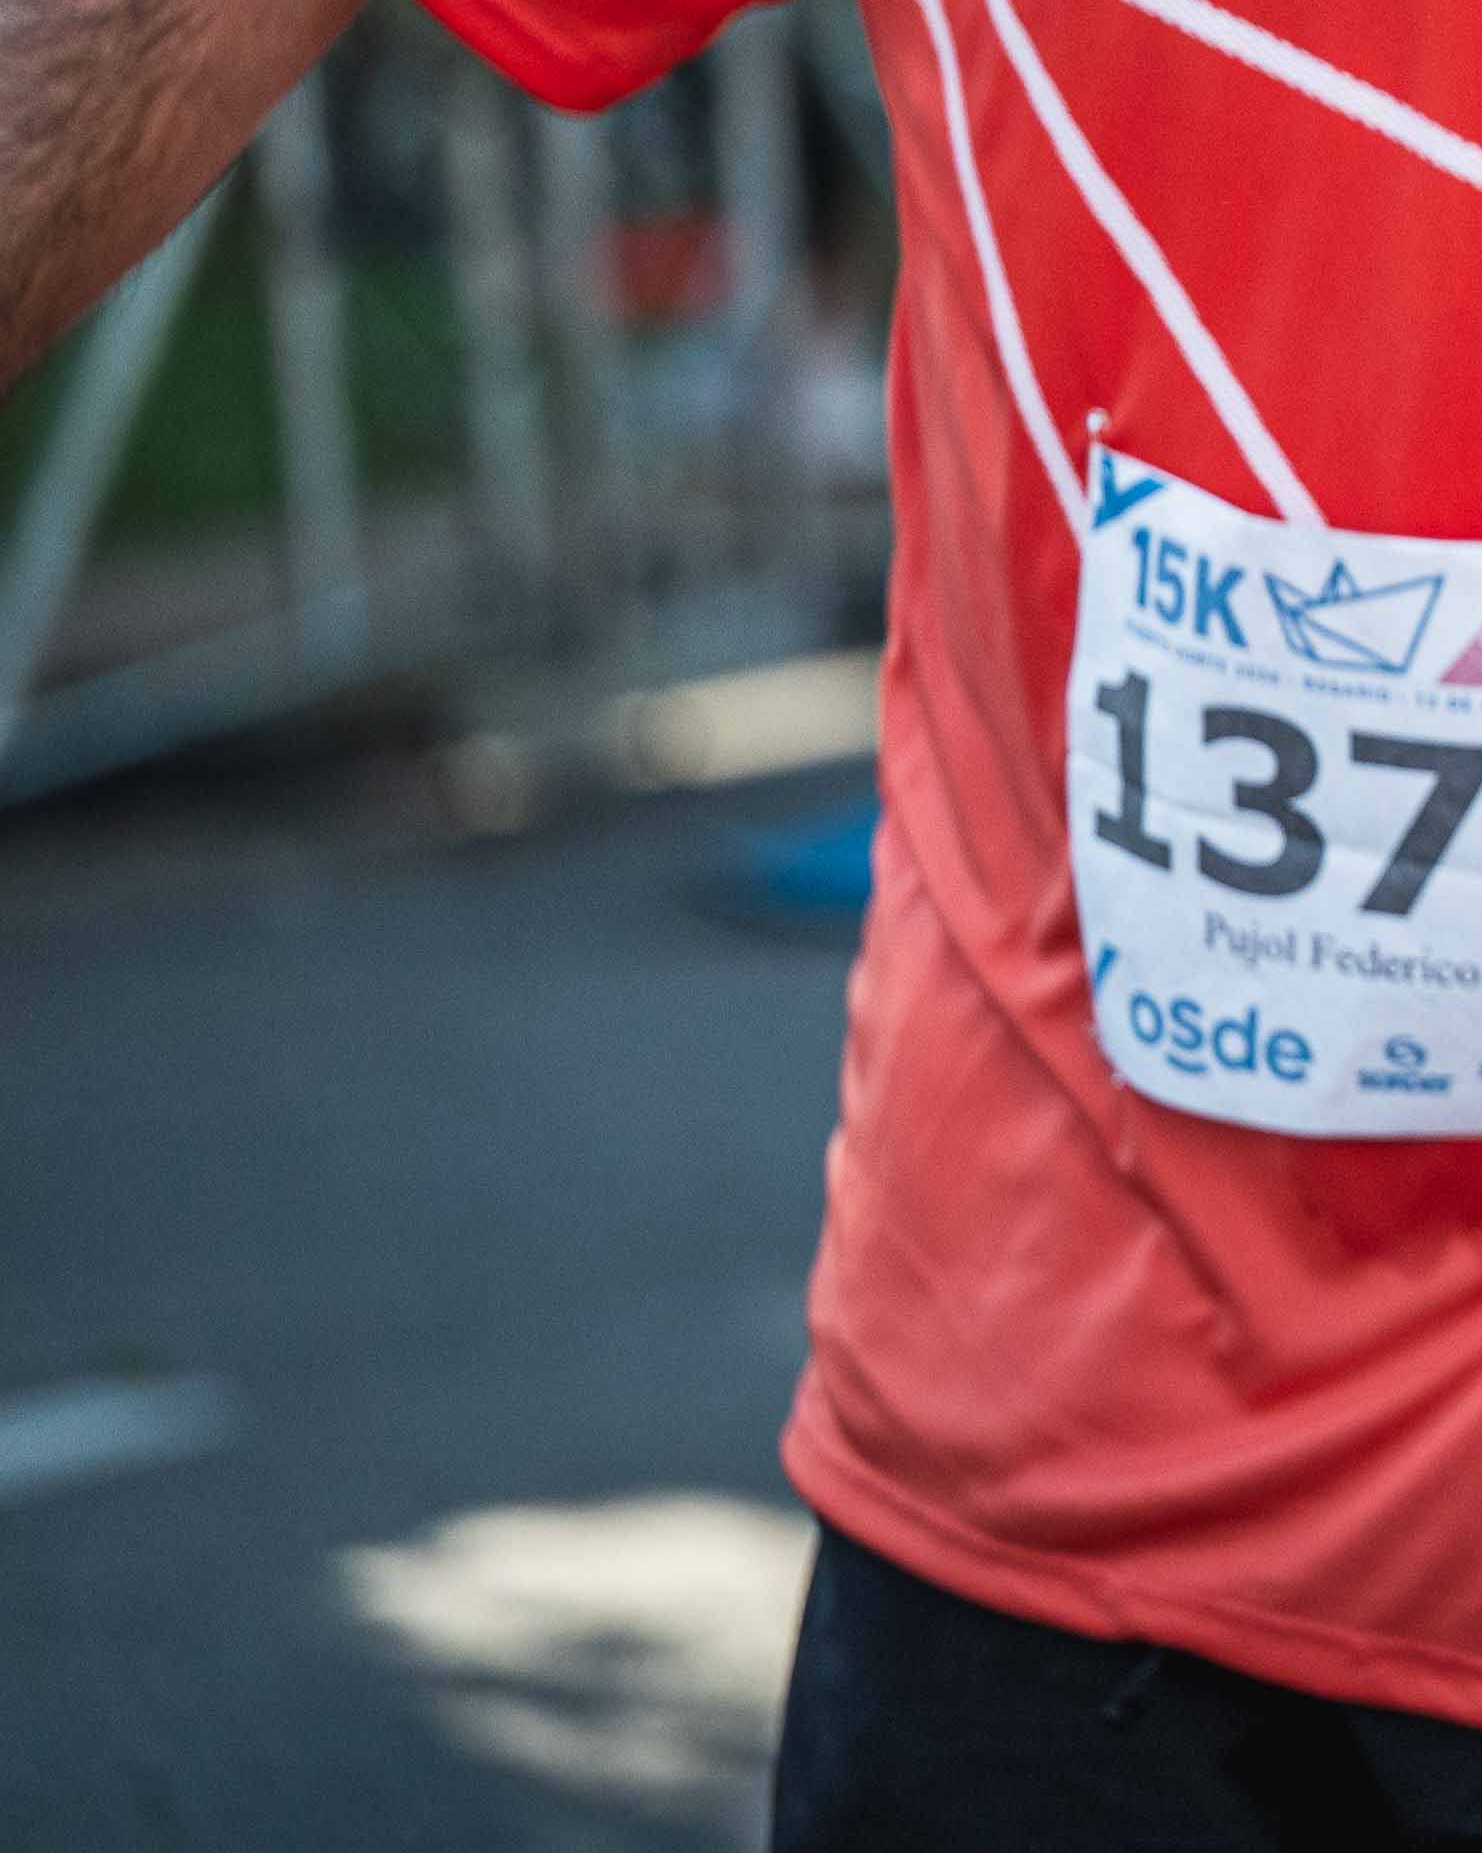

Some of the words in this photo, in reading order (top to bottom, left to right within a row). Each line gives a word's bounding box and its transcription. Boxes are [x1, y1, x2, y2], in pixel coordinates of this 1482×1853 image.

[1132, 526, 1248, 647] 15K
[1205, 911, 1296, 965] Pujol
[1312, 931, 1482, 986] Federico
[1129, 989, 1313, 1081] osde
